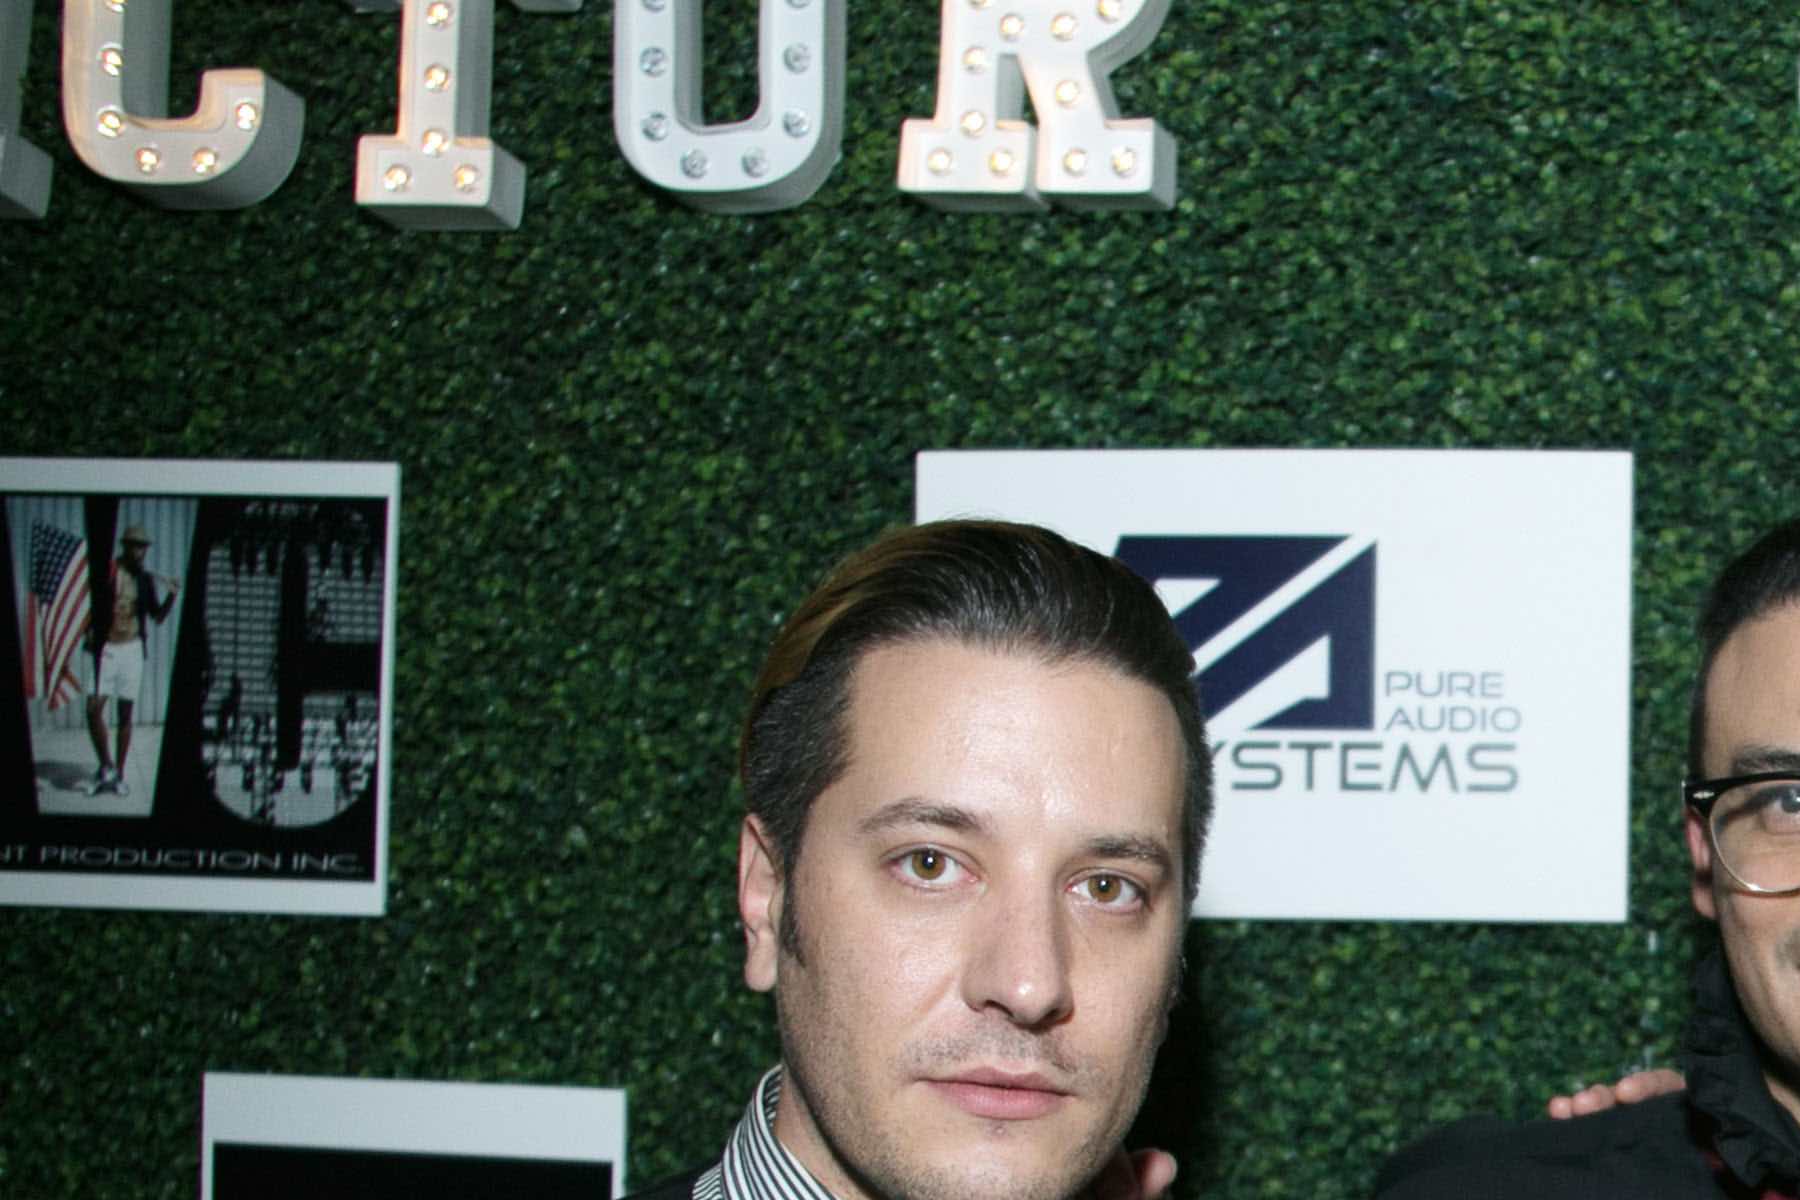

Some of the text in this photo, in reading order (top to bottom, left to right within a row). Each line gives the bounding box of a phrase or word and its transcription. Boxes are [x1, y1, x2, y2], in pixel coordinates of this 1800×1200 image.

[1384, 671, 1504, 699] PURE
[1383, 705, 1523, 733] AUDIO
[1212, 741, 1519, 794] STEMS
[40, 846, 281, 871] PRODUCTION
